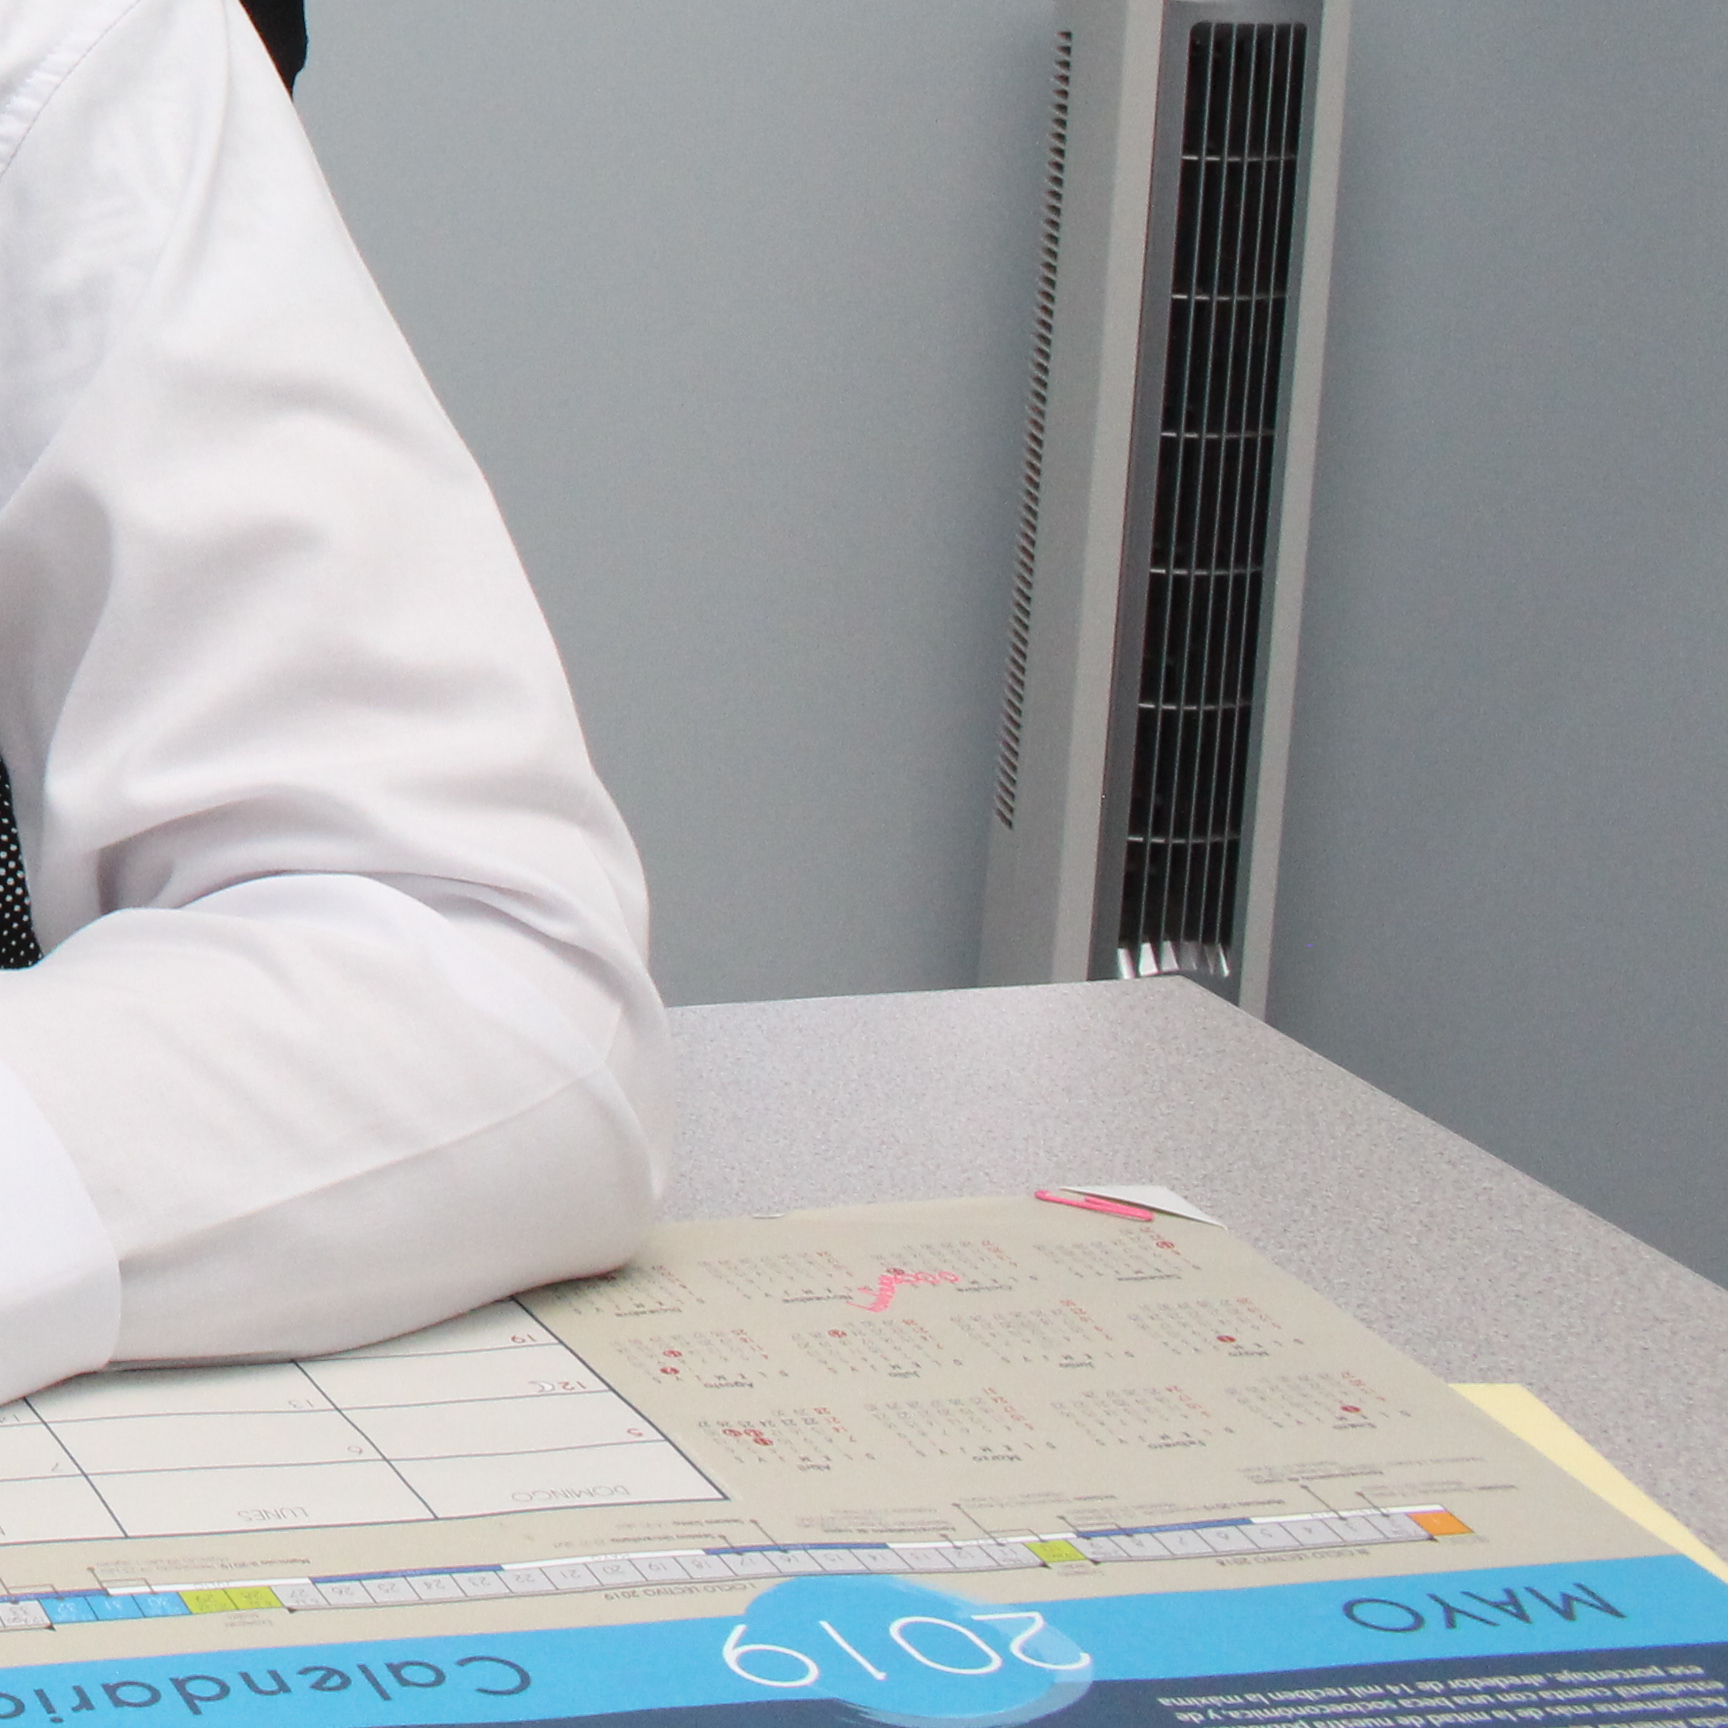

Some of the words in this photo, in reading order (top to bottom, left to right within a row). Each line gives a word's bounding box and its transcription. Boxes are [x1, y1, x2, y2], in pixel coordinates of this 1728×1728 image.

[509, 1333, 537, 1345] 19
[557, 1381, 586, 1391] 12
[287, 1398, 314, 1409] 13
[626, 1428, 643, 1438] 5
[347, 1445, 363, 1457] 6
[511, 1485, 629, 1502] DOMINGO
[236, 1506, 308, 1522] LUNES
[602, 1565, 623, 1575] 20
[648, 1561, 667, 1571] 19
[690, 1559, 712, 1569] 18
[515, 1574, 535, 1584] 22
[559, 1569, 578, 1579] 21
[378, 1583, 400, 1593] 25
[423, 1579, 445, 1590] 24
[467, 1577, 490, 1587] 23
[703, 1582, 747, 1593] CICLO
[289, 1588, 308, 1599] 27
[331, 1587, 354, 1597] 26
[603, 1590, 637, 1601] 2019
[643, 1585, 701, 1597] LECTIVO
[1342, 1583, 1626, 1633] MAYO
[722, 1611, 1091, 1687] 2019
[1664, 1665, 1704, 1675] ese
[1385, 1683, 1415, 1694] 14
[1415, 1681, 1444, 1693] de
[1447, 1675, 1547, 1690] alrededor
[1267, 1687, 1348, 1701] reciben
[1348, 1685, 1385, 1698] mil
[1538, 1687, 1612, 1700] cuenta
[1613, 1680, 1724, 1698] estudiantil
[1156, 1694, 1244, 1708] máxima
[1244, 1693, 1270, 1705] la
[1398, 1697, 1455, 1709] beca
[1452, 1694, 1496, 1705] una
[1495, 1691, 1538, 1703] con
[1545, 1704, 1593, 1718] más
[1592, 1696, 1727, 1714] Actualmente
[1175, 1712, 1205, 1724] de
[1426, 1711, 1492, 1727] mitad
[1491, 1709, 1518, 1722] la
[1514, 1707, 1545, 1721] de
[1395, 1715, 1425, 1728] de
